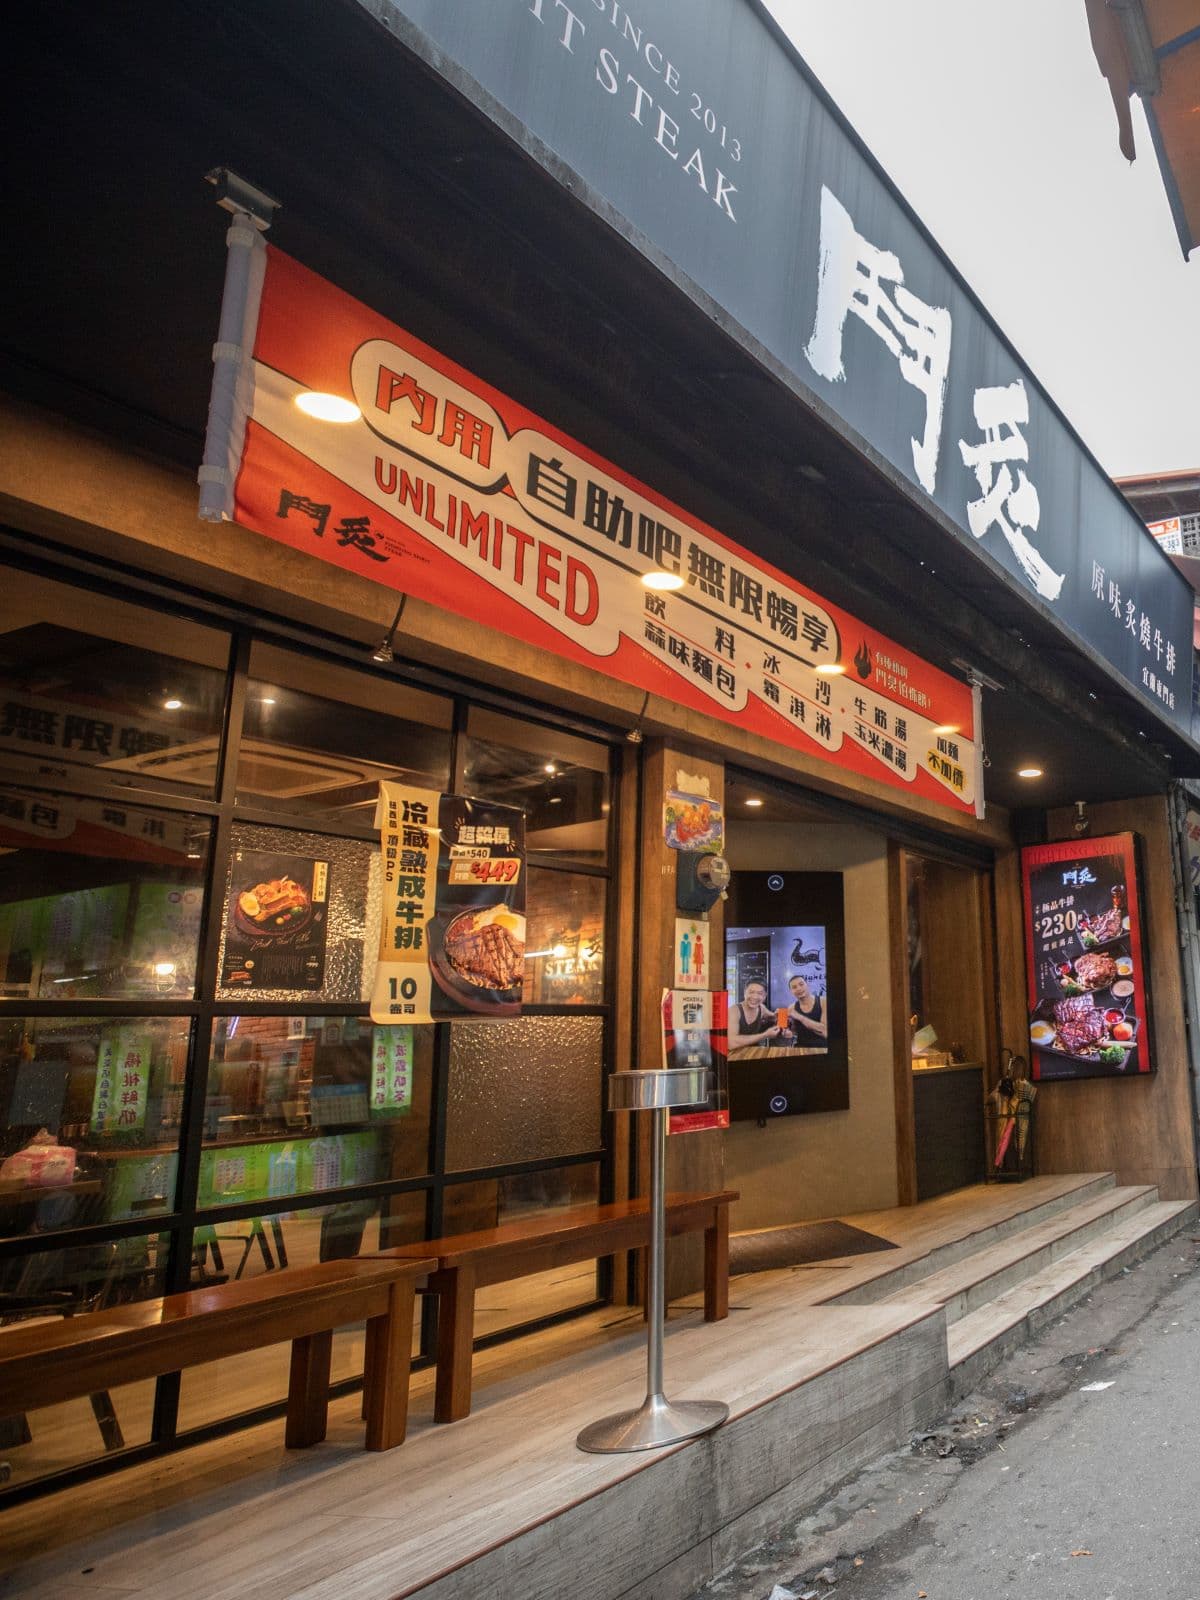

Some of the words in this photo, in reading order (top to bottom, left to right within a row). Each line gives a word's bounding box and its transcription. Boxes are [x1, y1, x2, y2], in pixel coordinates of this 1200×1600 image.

[596, 48, 737, 223] STEAK
[690, 92, 741, 162] 2013
[375, 365, 494, 469] 內用
[374, 456, 599, 626] UNLIMITED
[526, 452, 829, 653] 自助吧無限暢享
[1091, 560, 1176, 675] 原味炙燒牛排
[644, 621, 735, 699] 蒜味麵包
[764, 652, 831, 706] 冰沙
[1142, 666, 1175, 711] 宜蘭東門店
[764, 679, 832, 740] 霜淇淋
[854, 697, 907, 740] 牛筋湯
[854, 721, 907, 772] 玉米濃湯
[394, 800, 429, 950] 冷藏熟成牛排
[471, 860, 518, 883] $449
[1035, 910, 1077, 938] $230
[389, 978, 417, 1000] 10
